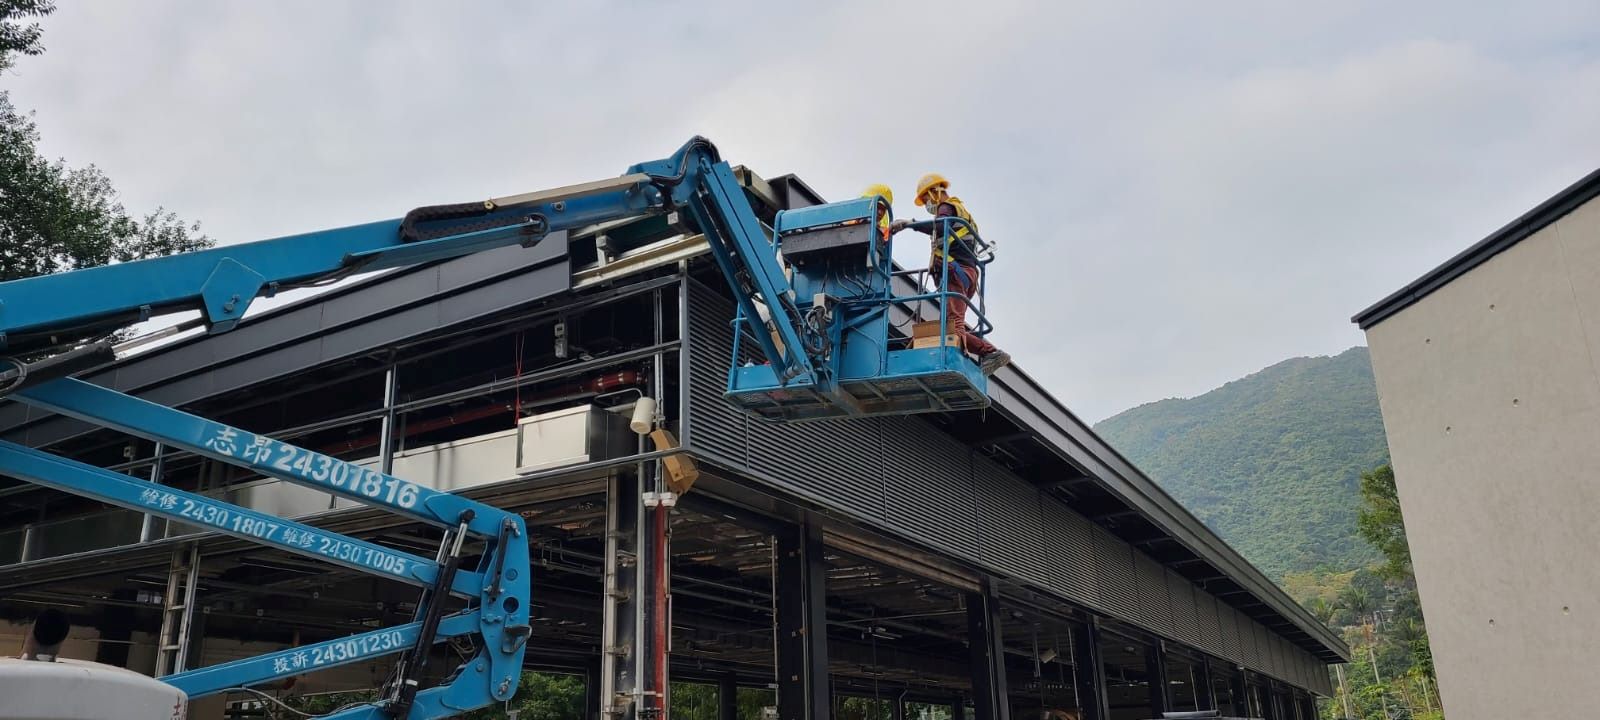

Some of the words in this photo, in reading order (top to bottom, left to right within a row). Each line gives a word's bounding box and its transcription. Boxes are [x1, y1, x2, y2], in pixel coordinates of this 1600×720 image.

[206, 427, 272, 464] 志昂
[274, 445, 420, 509] 24301816
[140, 488, 178, 510] 維修
[180, 500, 229, 527] 2430
[232, 515, 279, 539] 1807
[282, 527, 315, 548] 維修
[320, 538, 361, 563] 2430
[365, 547, 406, 574] 1005
[273, 651, 309, 674] 投訴
[311, 631, 402, 665] 24301230
